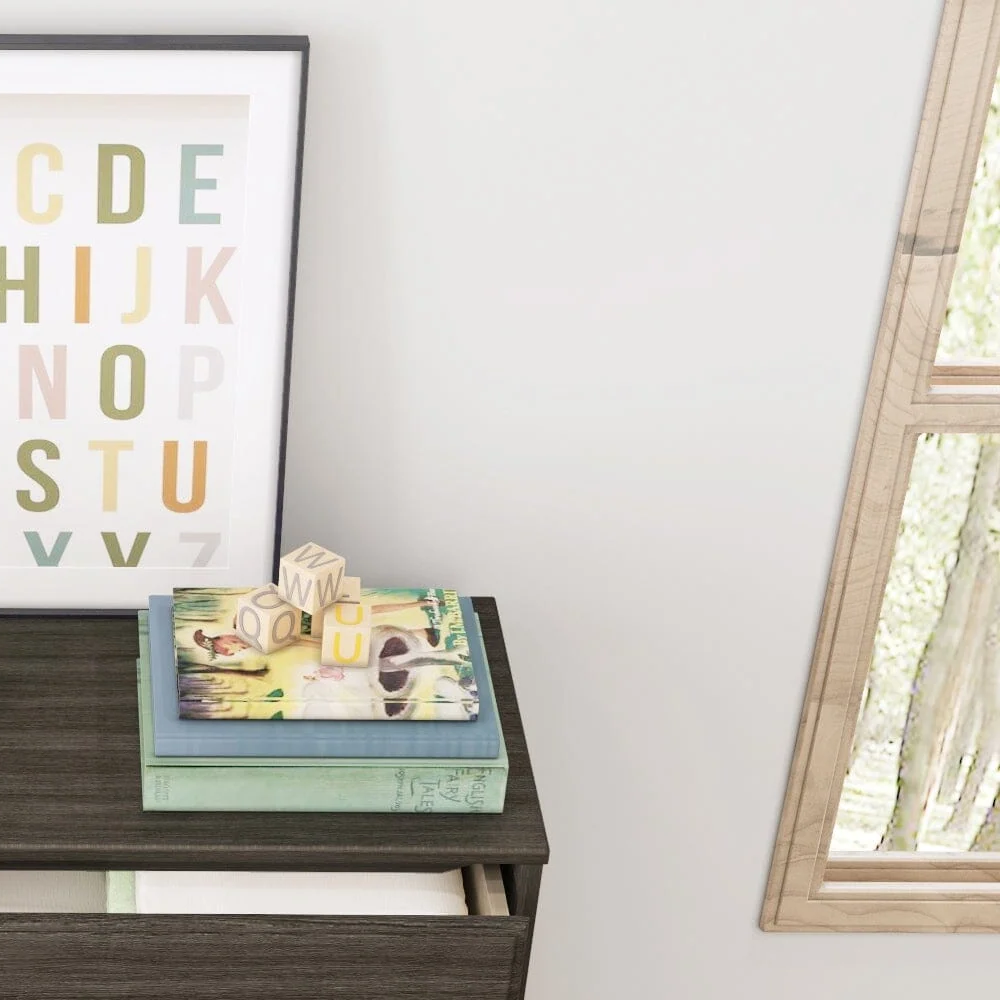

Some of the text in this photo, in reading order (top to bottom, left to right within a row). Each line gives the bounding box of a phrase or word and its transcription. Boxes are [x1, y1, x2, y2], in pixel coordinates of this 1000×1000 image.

[17, 142, 63, 224] C
[97, 143, 145, 224] D
[179, 144, 224, 224] E
[74, 246, 91, 324] I
[121, 246, 151, 324] J
[184, 246, 237, 325] K
[18, 345, 67, 420] N
[100, 344, 146, 420] O
[178, 345, 225, 420] P
[16, 439, 60, 512] S
[88, 440, 134, 512] T
[162, 440, 207, 513] U
[282, 565, 313, 608] W
[316, 565, 344, 608] W
[333, 631, 362, 664] U
